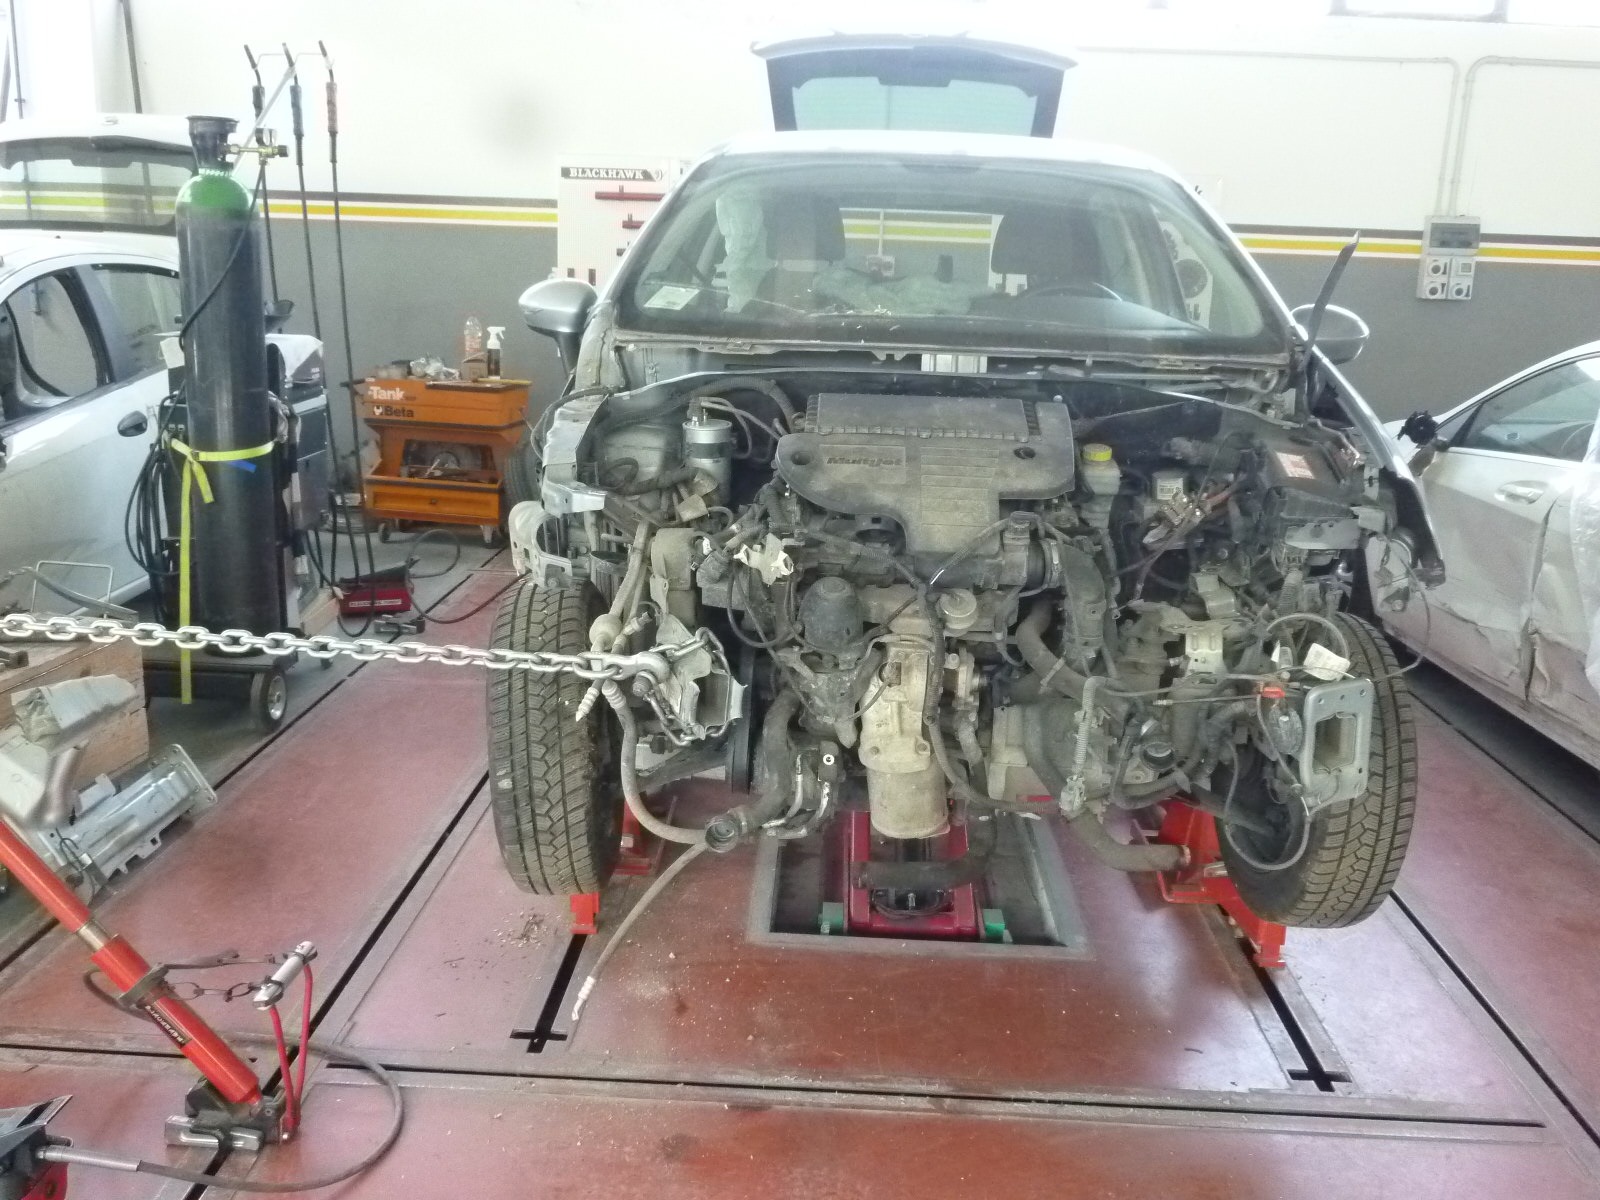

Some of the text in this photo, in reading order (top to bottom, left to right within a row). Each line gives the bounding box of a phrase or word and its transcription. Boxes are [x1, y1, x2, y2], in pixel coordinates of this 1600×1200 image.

[569, 168, 644, 179] BLACKHAWK
[370, 386, 405, 400] Tank
[384, 406, 414, 417] Beta
